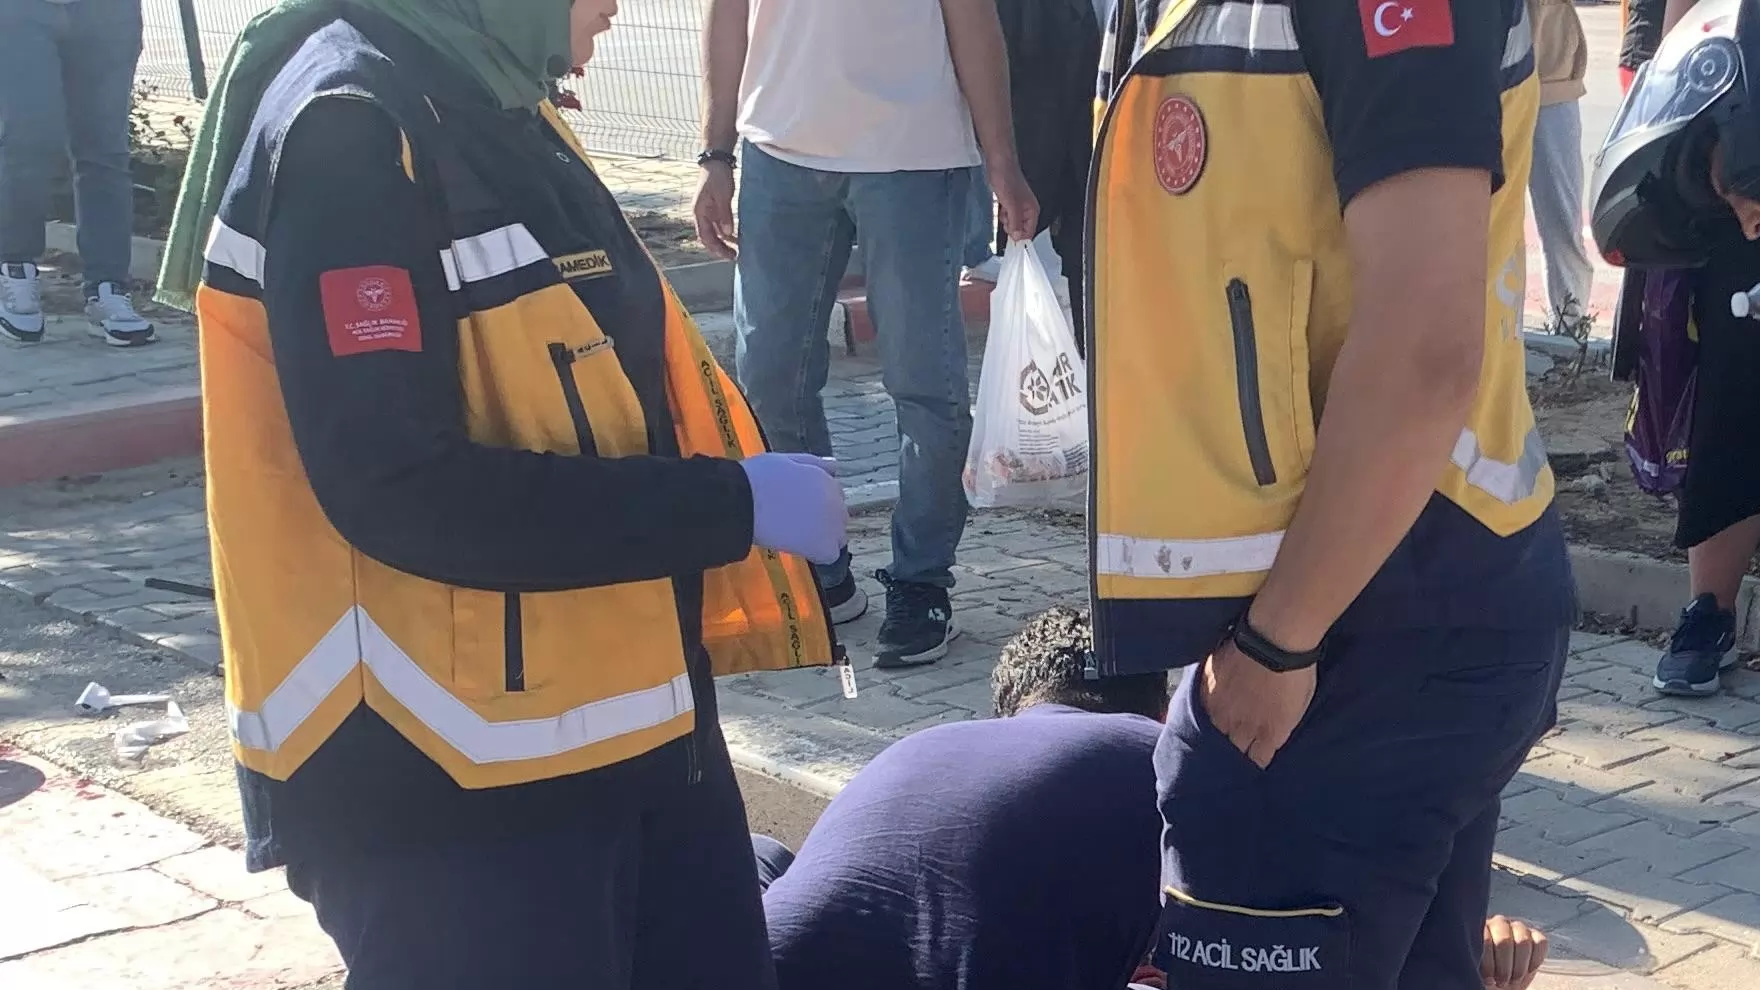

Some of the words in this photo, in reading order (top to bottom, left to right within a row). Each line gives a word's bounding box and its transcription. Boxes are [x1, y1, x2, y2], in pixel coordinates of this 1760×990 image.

[560, 254, 610, 273] AMEDİK
[1168, 931, 1191, 960] 112
[1192, 938, 1238, 970] ACİL
[1241, 944, 1322, 972] SAĞLIK
